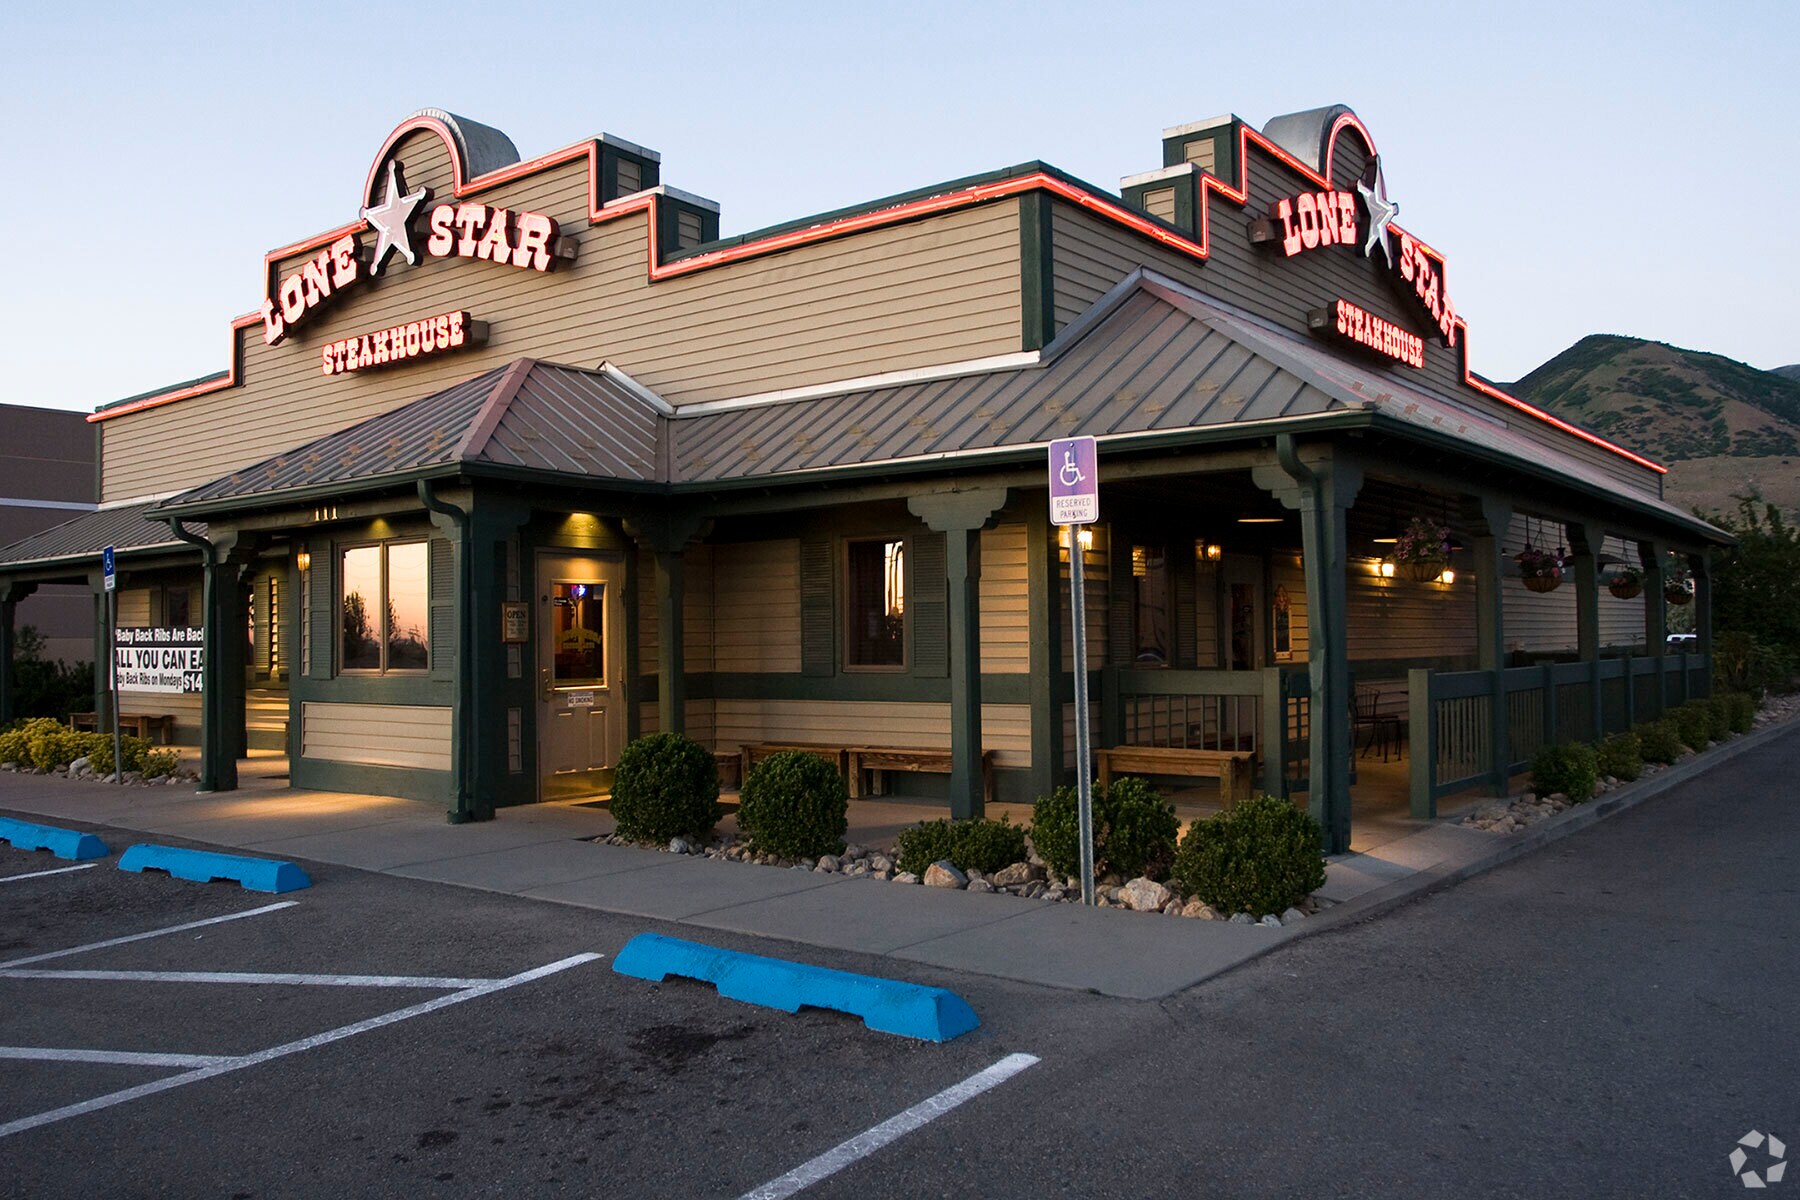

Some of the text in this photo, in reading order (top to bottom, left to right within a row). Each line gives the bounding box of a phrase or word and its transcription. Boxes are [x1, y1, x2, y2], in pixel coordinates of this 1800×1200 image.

[260, 202, 553, 346] LONE STAR
[1278, 190, 1457, 348] LONE STAR
[321, 310, 465, 376] STEAKHOUSE
[1336, 298, 1425, 369] STEAKHOUSE
[1056, 497, 1091, 508] RESERVED
[314, 507, 338, 521] 111
[1060, 508, 1088, 519] PARKING
[506, 610, 526, 619] OPEN
[135, 628, 153, 642] Back
[154, 627, 171, 642] Ribs
[171, 627, 186, 642] Are
[136, 649, 159, 670] YOU
[162, 649, 186, 670] CAN
[126, 671, 139, 685] Back
[139, 672, 151, 686] Ribs
[151, 676, 158, 686] on
[158, 673, 182, 690] Mondays
